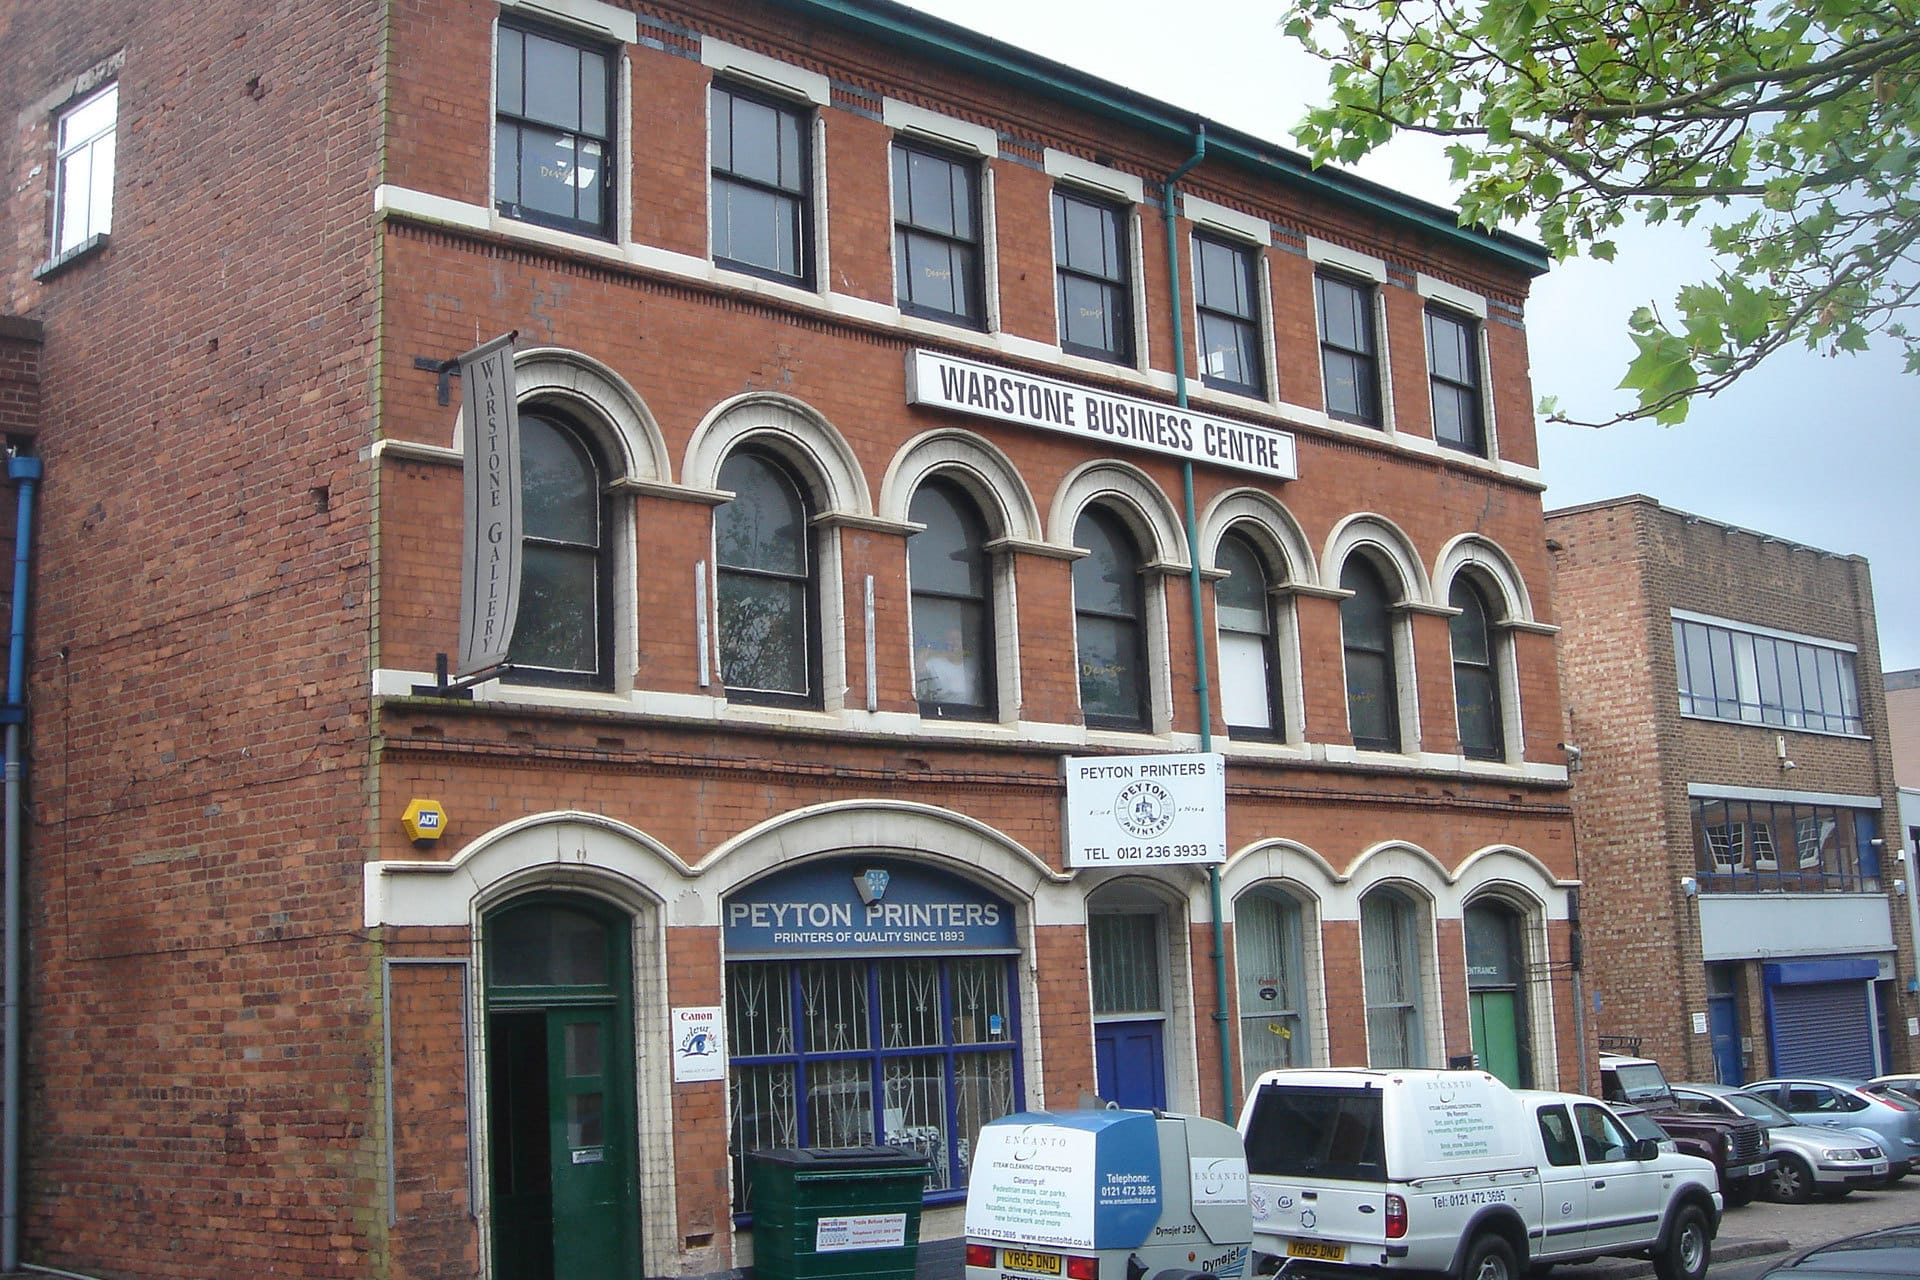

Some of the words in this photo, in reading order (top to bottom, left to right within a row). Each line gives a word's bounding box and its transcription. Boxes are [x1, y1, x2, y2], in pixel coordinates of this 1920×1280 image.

[939, 364, 1076, 427] WARSTONE
[1086, 397, 1194, 452] BUSINESS
[1203, 423, 1280, 470] CENTRE
[481, 358, 501, 508] WARSTONE
[482, 521, 503, 653] GALLERY
[1080, 765, 1133, 780] PEYTON
[1140, 763, 1206, 777] PRINTERS
[1121, 783, 1167, 801] PEYTON
[420, 814, 438, 826] ADT
[1123, 815, 1170, 836] PRINTERS
[1084, 848, 1109, 860] TEL
[1117, 847, 1142, 859] 0121
[1145, 846, 1170, 858] 236
[1174, 844, 1207, 857] 3933
[730, 903, 851, 928] PEYTON
[866, 903, 999, 927] PRINTERS
[774, 931, 836, 943] PRINTERS
[837, 931, 851, 943] OF
[854, 931, 902, 943] QUALITY
[904, 931, 936, 942] SINCE
[940, 931, 965, 942] 1893
[681, 1012, 713, 1021] Canon
[1005, 1135, 1067, 1147] ENCANTO
[1034, 1164, 1072, 1173] CONTRACTORS
[1013, 1176, 1037, 1187] Cleaning
[1106, 1174, 1150, 1184] Telephone:
[1194, 1172, 1245, 1181] ENCANTO
[1101, 1187, 1120, 1196] 0121
[1122, 1186, 1136, 1196] 472
[1137, 1185, 1156, 1195] 3695
[1432, 1196, 1448, 1208] Tel:
[1450, 1194, 1469, 1206] 0121
[1471, 1192, 1486, 1204] 472
[1486, 1190, 1505, 1203] 3695
[1034, 1217, 1045, 1225] and
[966, 1226, 976, 1235] Tel:
[977, 1227, 990, 1236] 0121
[991, 1229, 1002, 1238] 472
[1156, 1225, 1181, 1237] Dynajet
[1182, 1225, 1196, 1234] 350
[1021, 1233, 1092, 1247] www.encantoltd.co.uk
[1292, 1240, 1318, 1256] YR05
[1320, 1243, 1340, 1259] DND
[1007, 1250, 1033, 1267] YR05
[1036, 1254, 1056, 1270] DND
[1202, 1247, 1240, 1272] Dynajet
